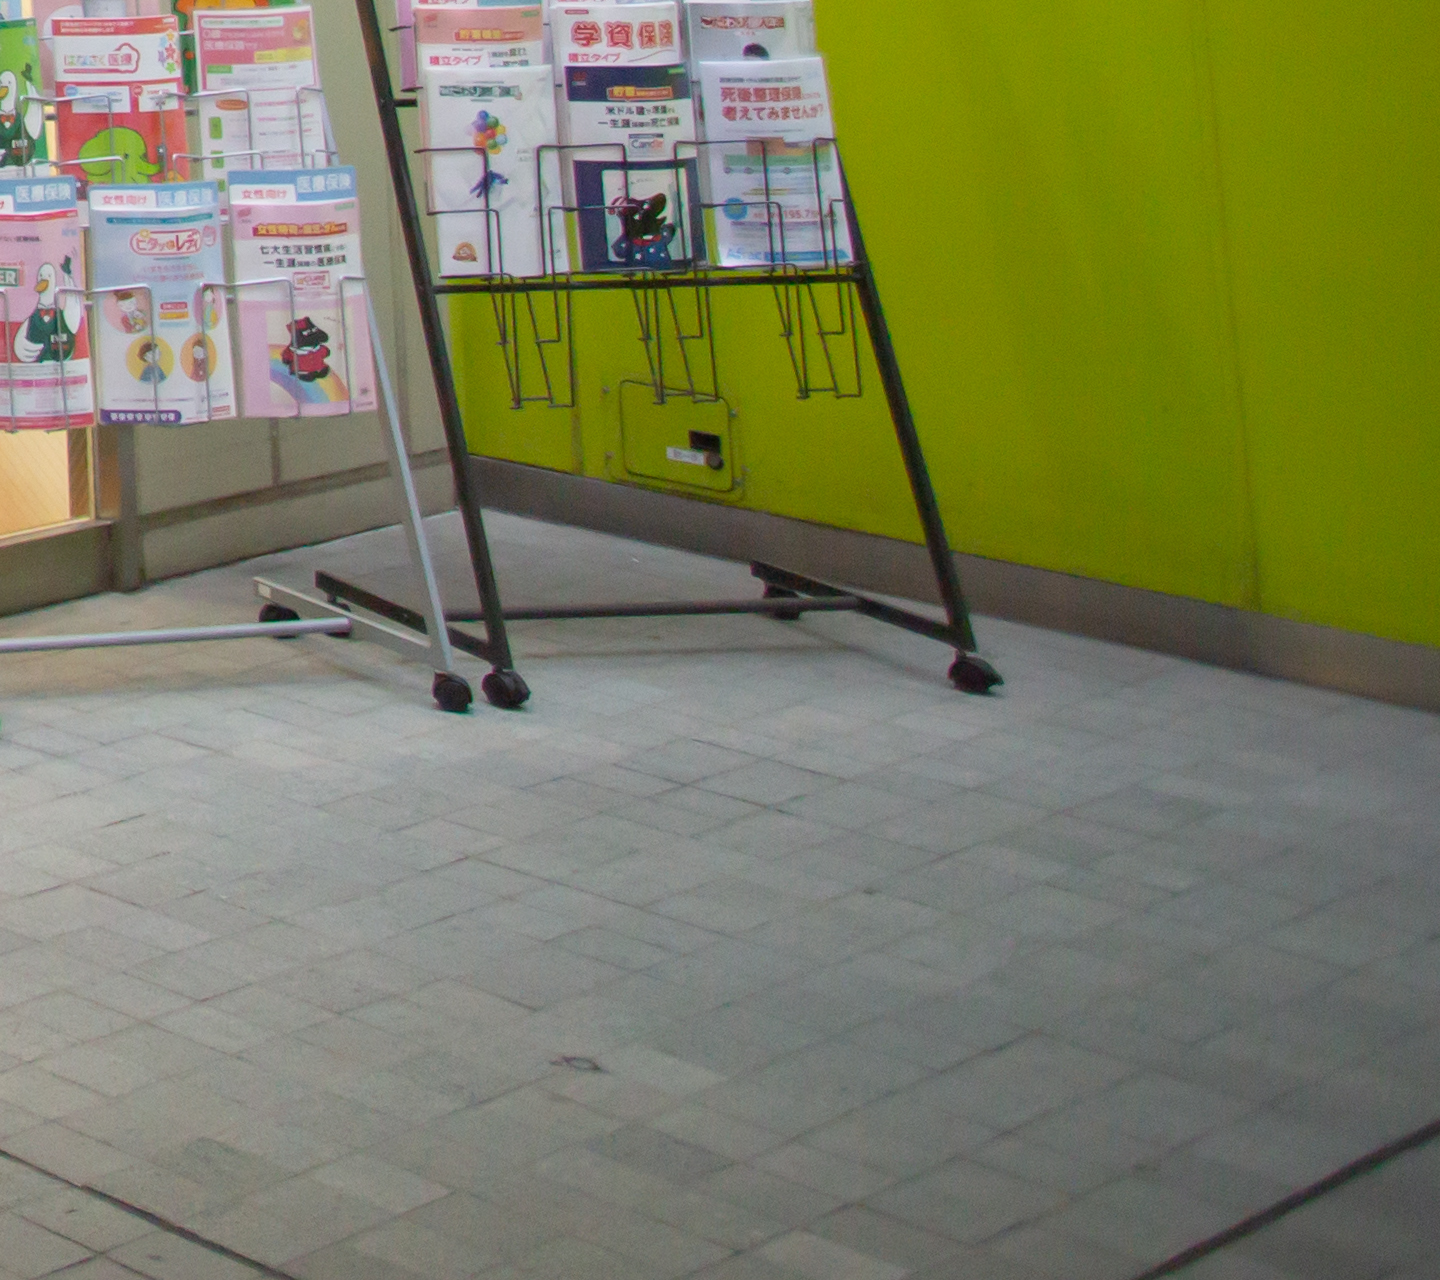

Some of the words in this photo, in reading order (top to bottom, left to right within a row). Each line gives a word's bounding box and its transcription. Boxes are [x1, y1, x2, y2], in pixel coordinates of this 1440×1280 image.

[571, 19, 674, 49] 学資保険
[102, 195, 147, 205] 女性向け
[242, 190, 287, 200] 女性向け
